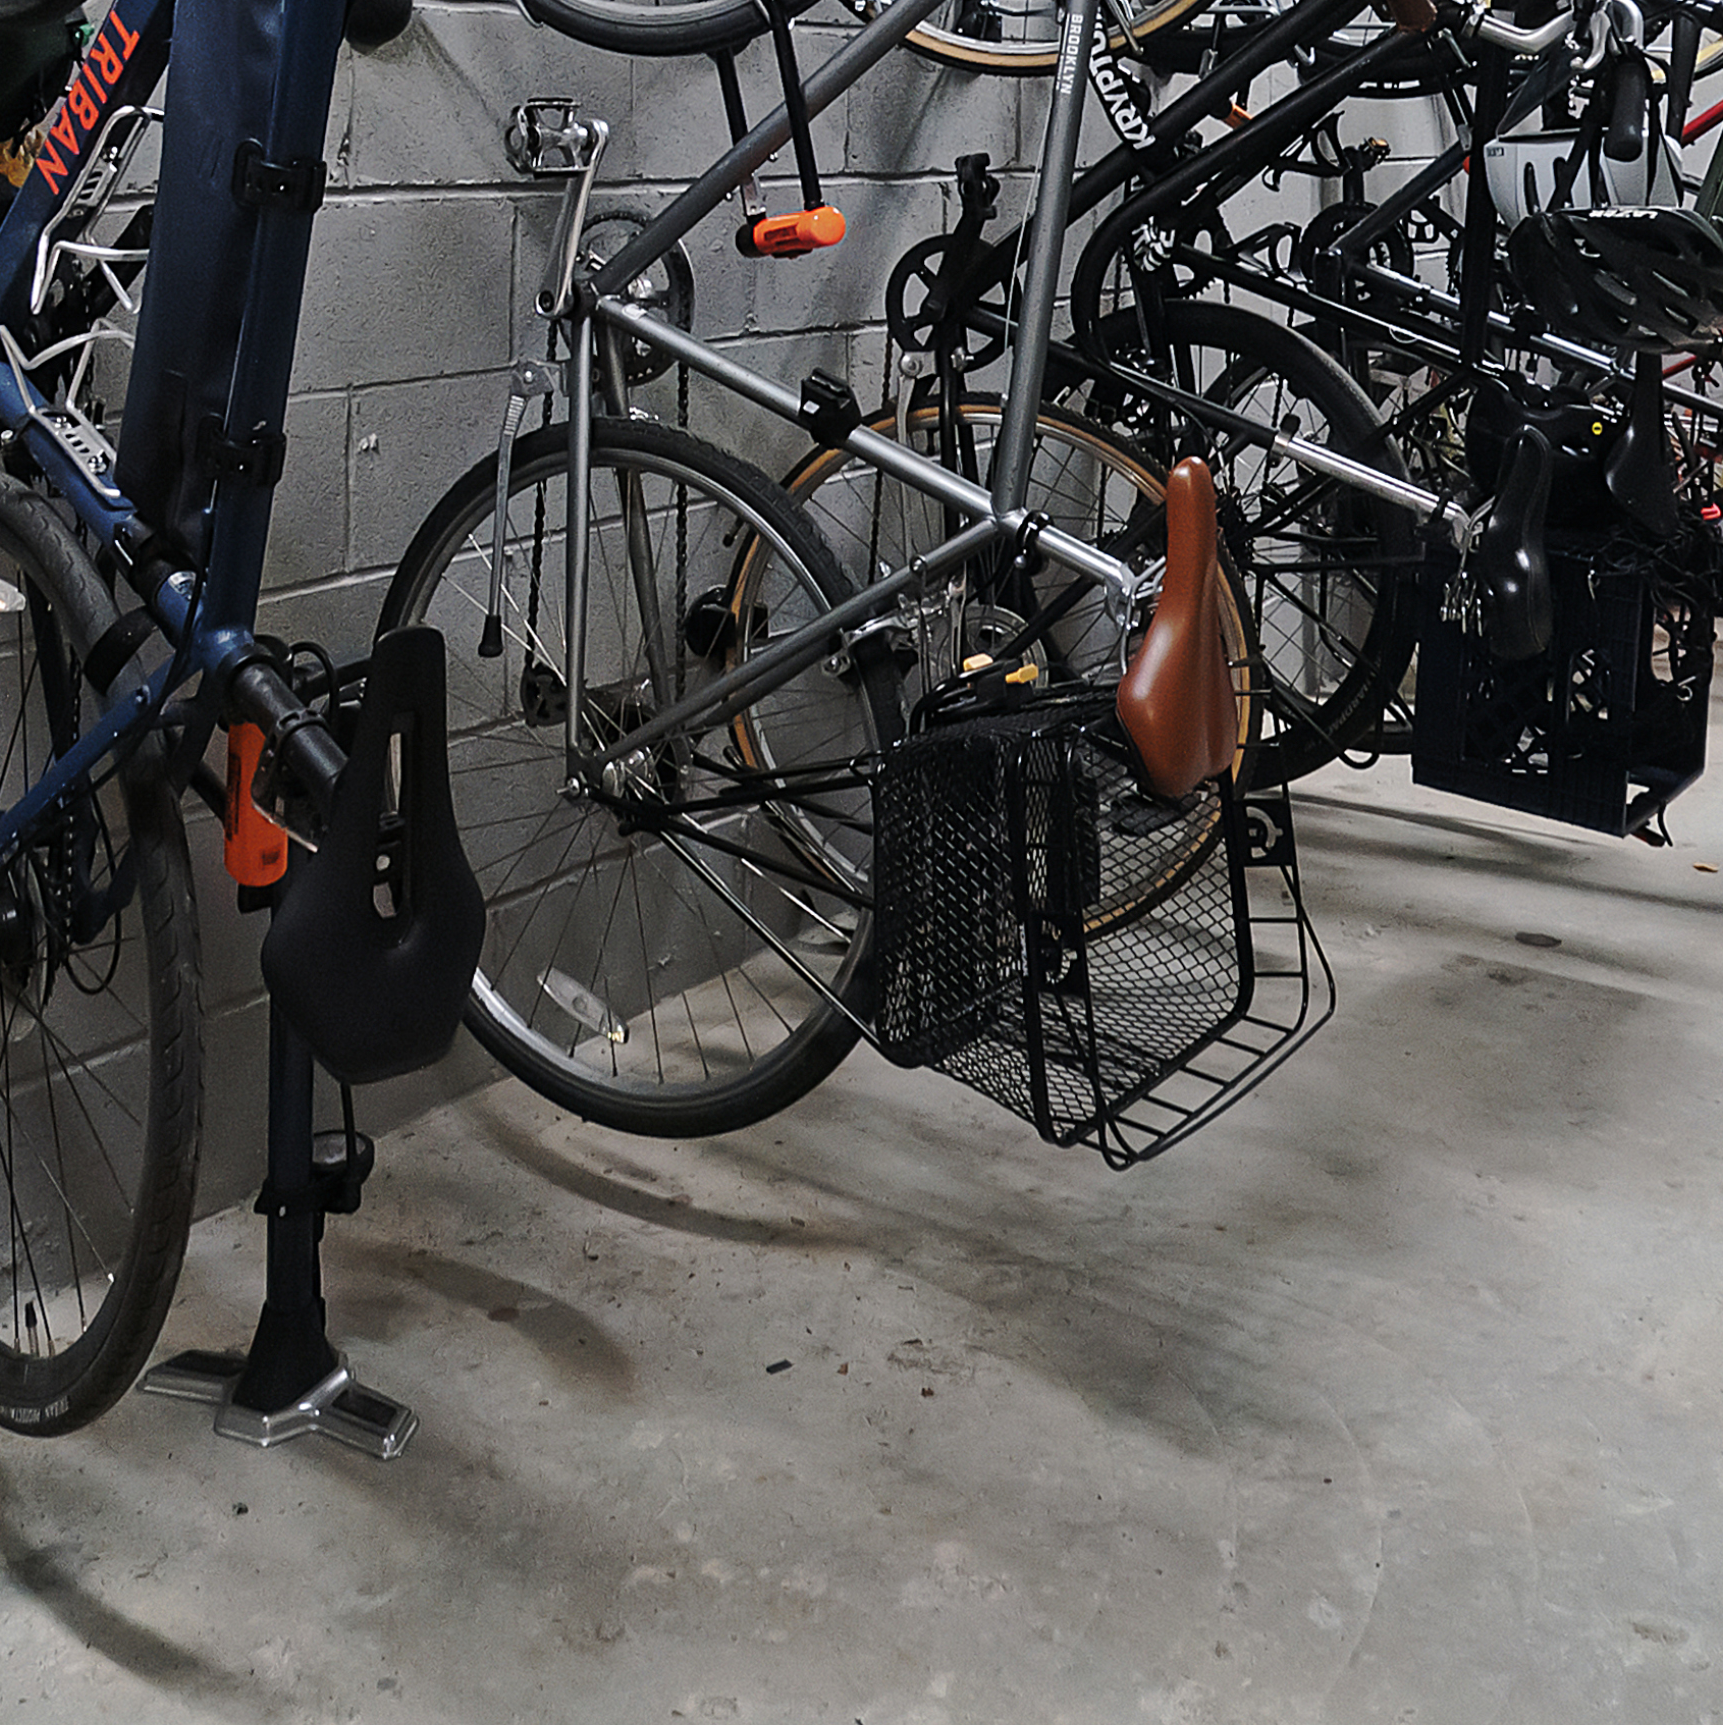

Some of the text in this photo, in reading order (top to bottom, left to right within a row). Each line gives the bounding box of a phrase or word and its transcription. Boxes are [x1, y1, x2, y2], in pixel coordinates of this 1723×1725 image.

[35, 10, 140, 195] TRIBAN
[1060, 13, 1084, 95] BROOKLYN
[1089, 11, 1157, 150] KRYPTO
